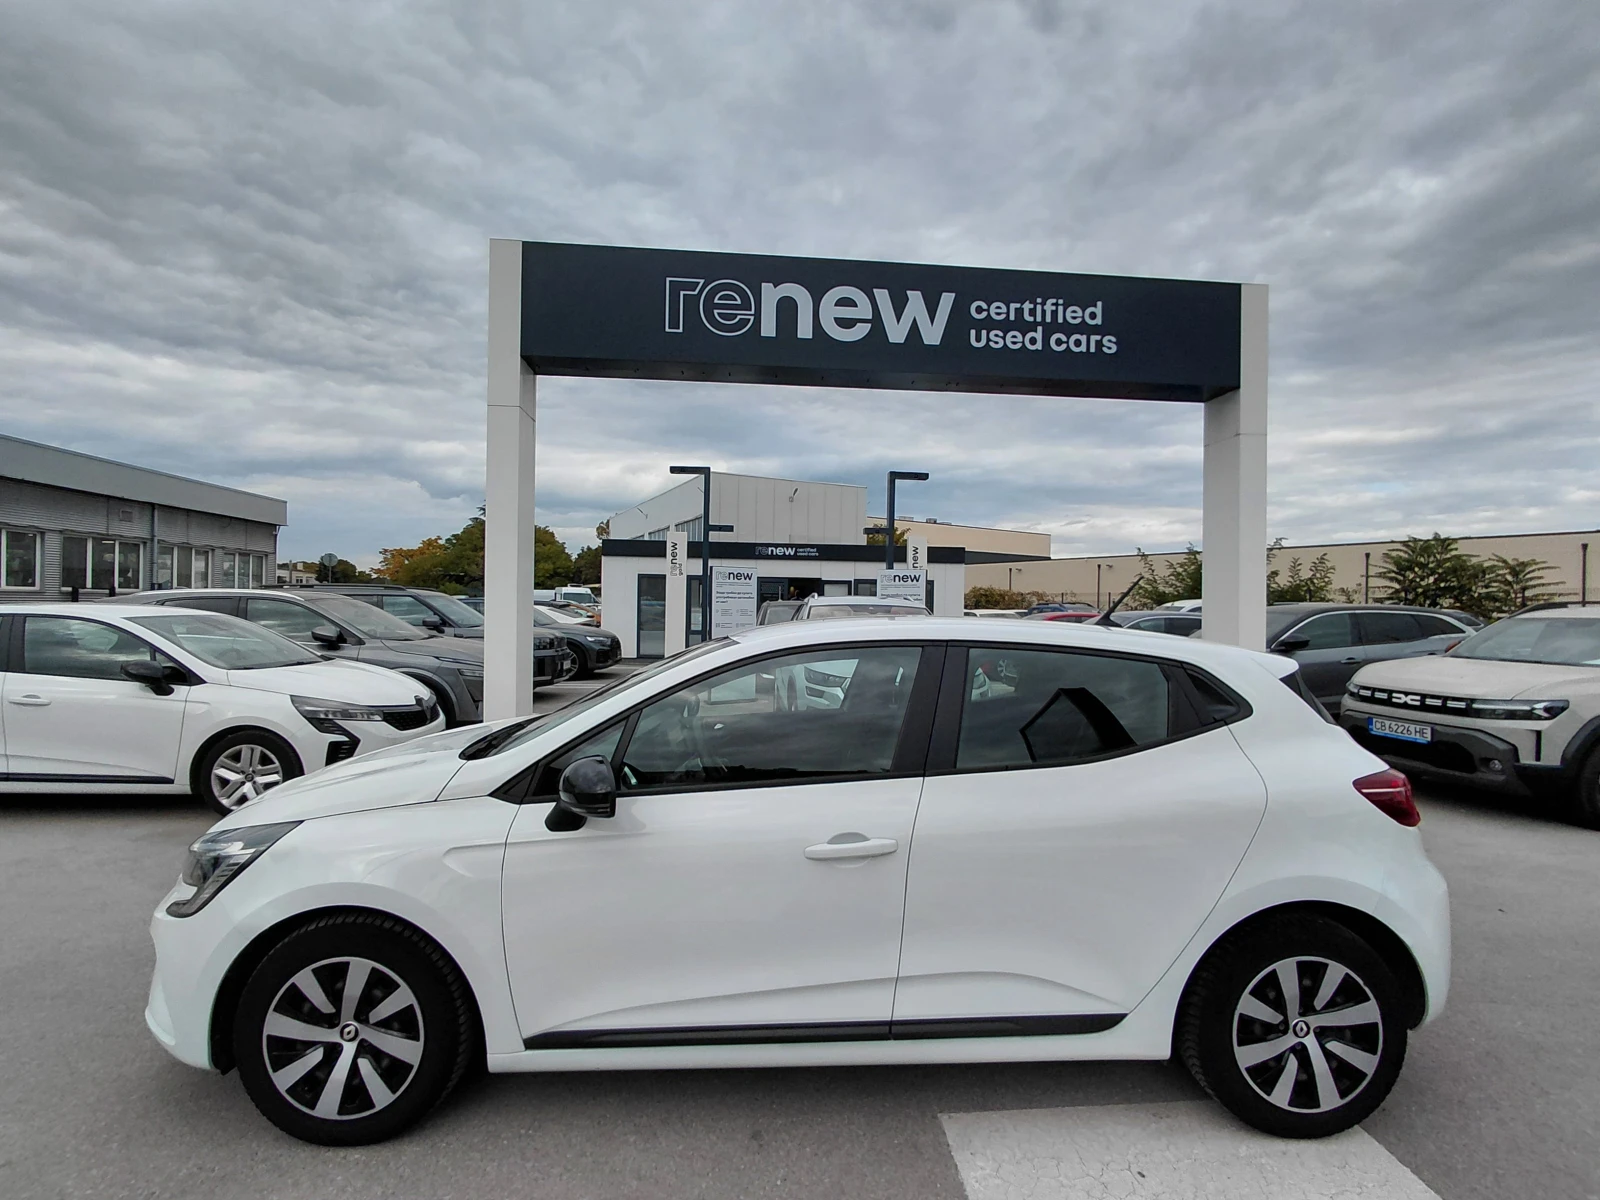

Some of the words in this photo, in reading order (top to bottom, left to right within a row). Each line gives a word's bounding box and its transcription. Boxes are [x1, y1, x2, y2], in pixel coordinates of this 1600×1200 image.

[665, 277, 956, 346] renew
[969, 297, 1103, 326] certified
[969, 325, 1043, 351] used
[1049, 332, 1118, 354] cars
[670, 541, 678, 576] renew
[755, 546, 796, 556] renew
[716, 571, 753, 581] renew
[880, 574, 921, 583] renew
[1374, 720, 1386, 731] CB
[1388, 723, 1412, 736] 6226
[1414, 727, 1429, 739] HE
